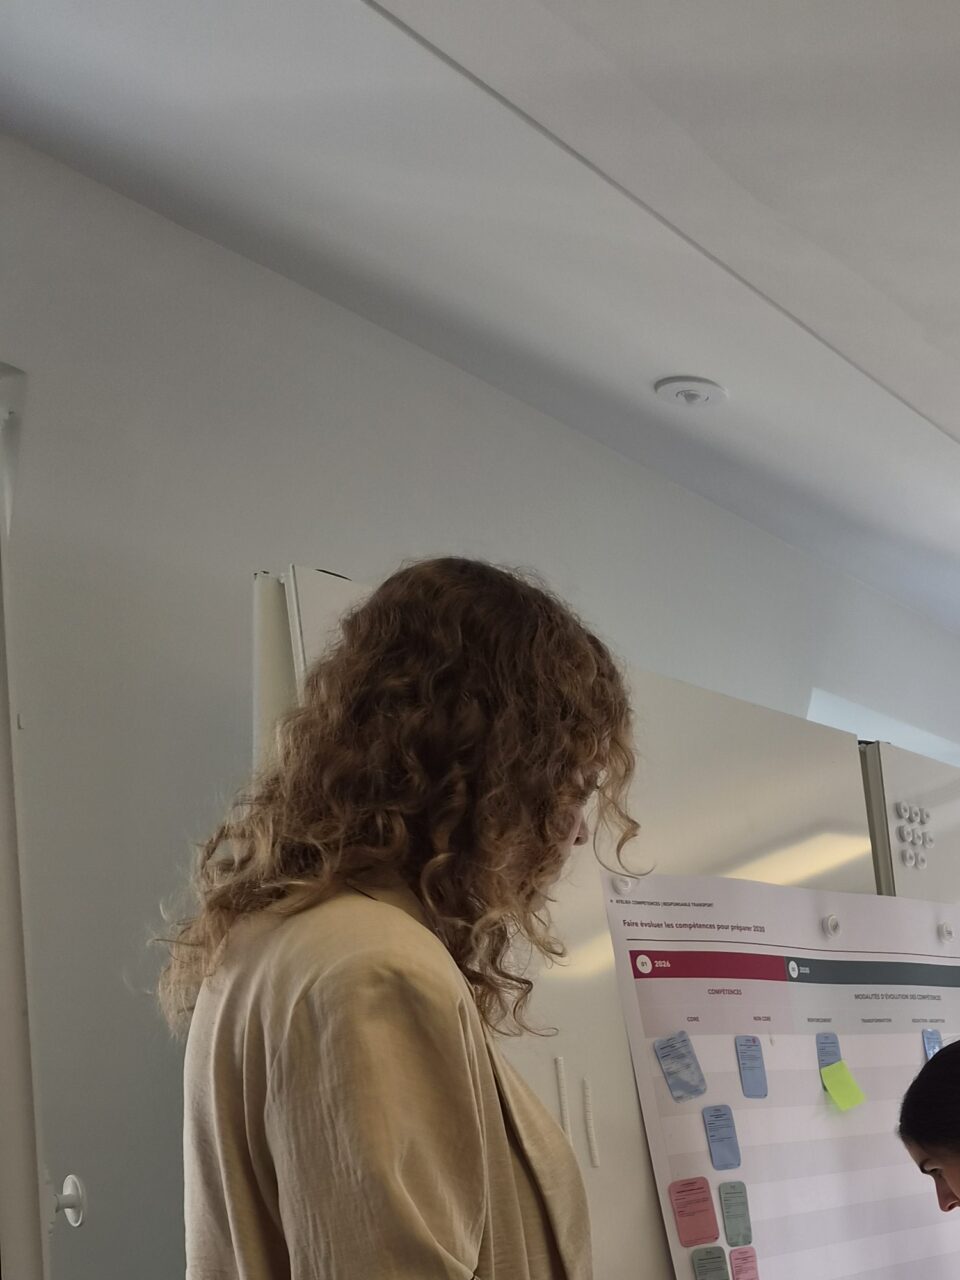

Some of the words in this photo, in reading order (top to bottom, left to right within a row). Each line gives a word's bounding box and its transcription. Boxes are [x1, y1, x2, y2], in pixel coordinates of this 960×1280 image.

[623, 920, 639, 928] Faire
[640, 920, 663, 929] évoluer
[664, 921, 674, 929] les
[675, 922, 716, 931] compétences
[716, 924, 730, 932] pour
[730, 923, 752, 933] préparer
